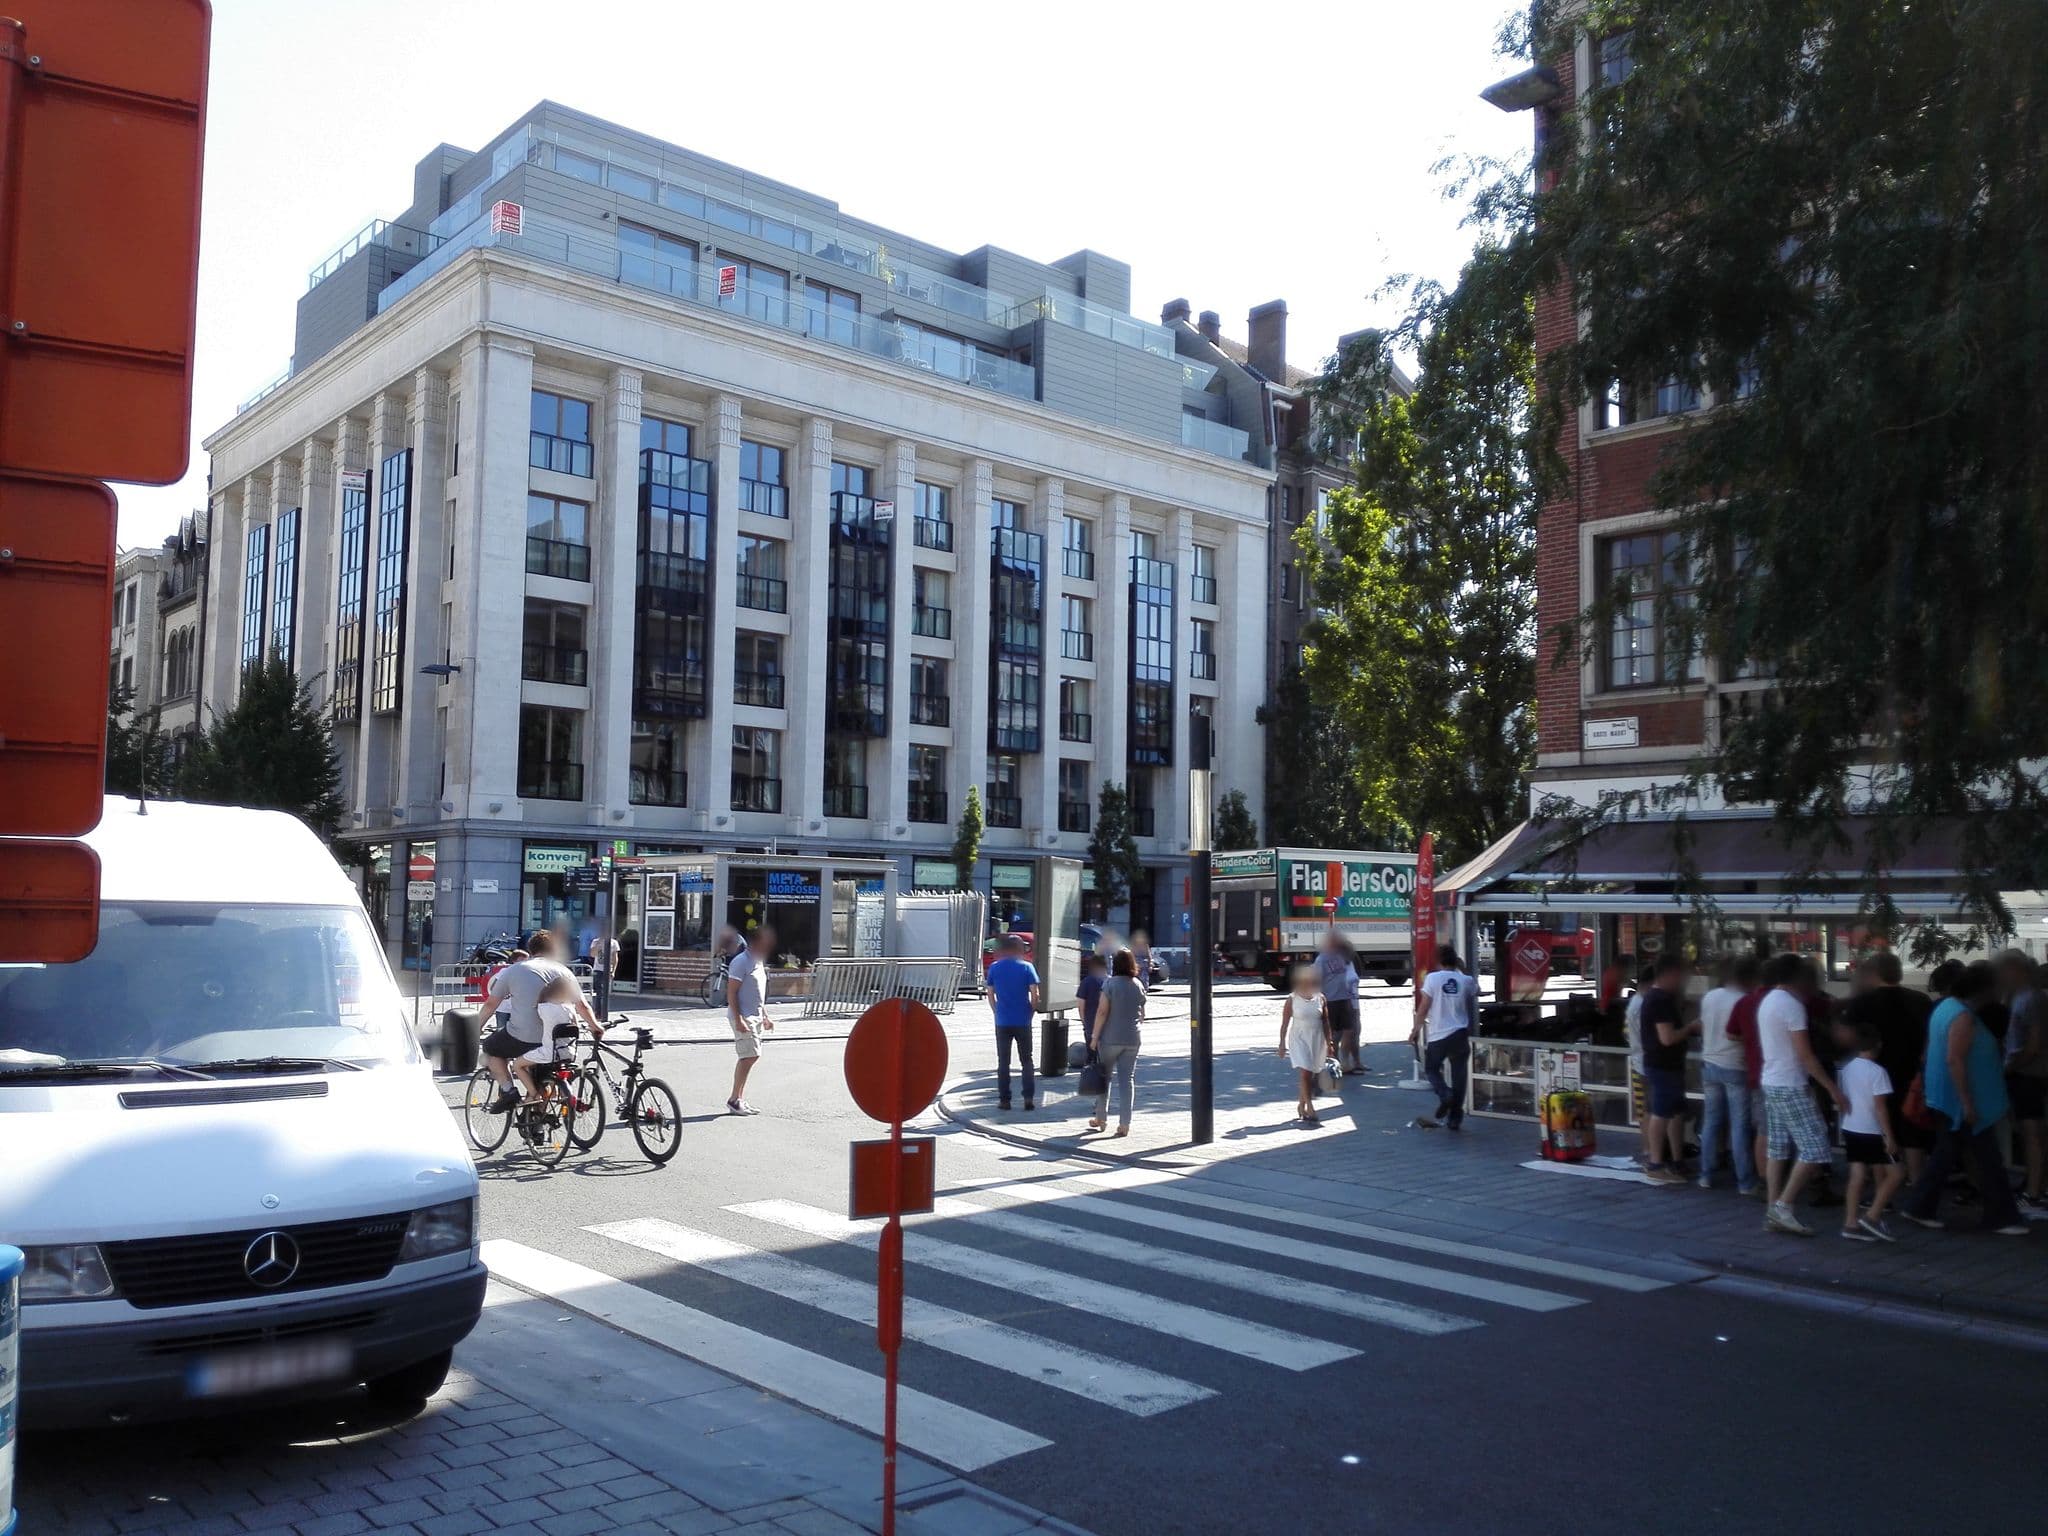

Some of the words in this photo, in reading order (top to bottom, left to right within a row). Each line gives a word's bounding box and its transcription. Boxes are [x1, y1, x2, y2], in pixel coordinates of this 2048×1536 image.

[528, 850, 583, 862] konvert
[1210, 855, 1271, 867] FlandersColor
[768, 872, 802, 884] META
[1292, 863, 1417, 894] FlaersCol
[768, 885, 820, 895] MORFOSEN
[1348, 896, 1383, 908] COLOUR
[1393, 897, 1412, 909] COA
